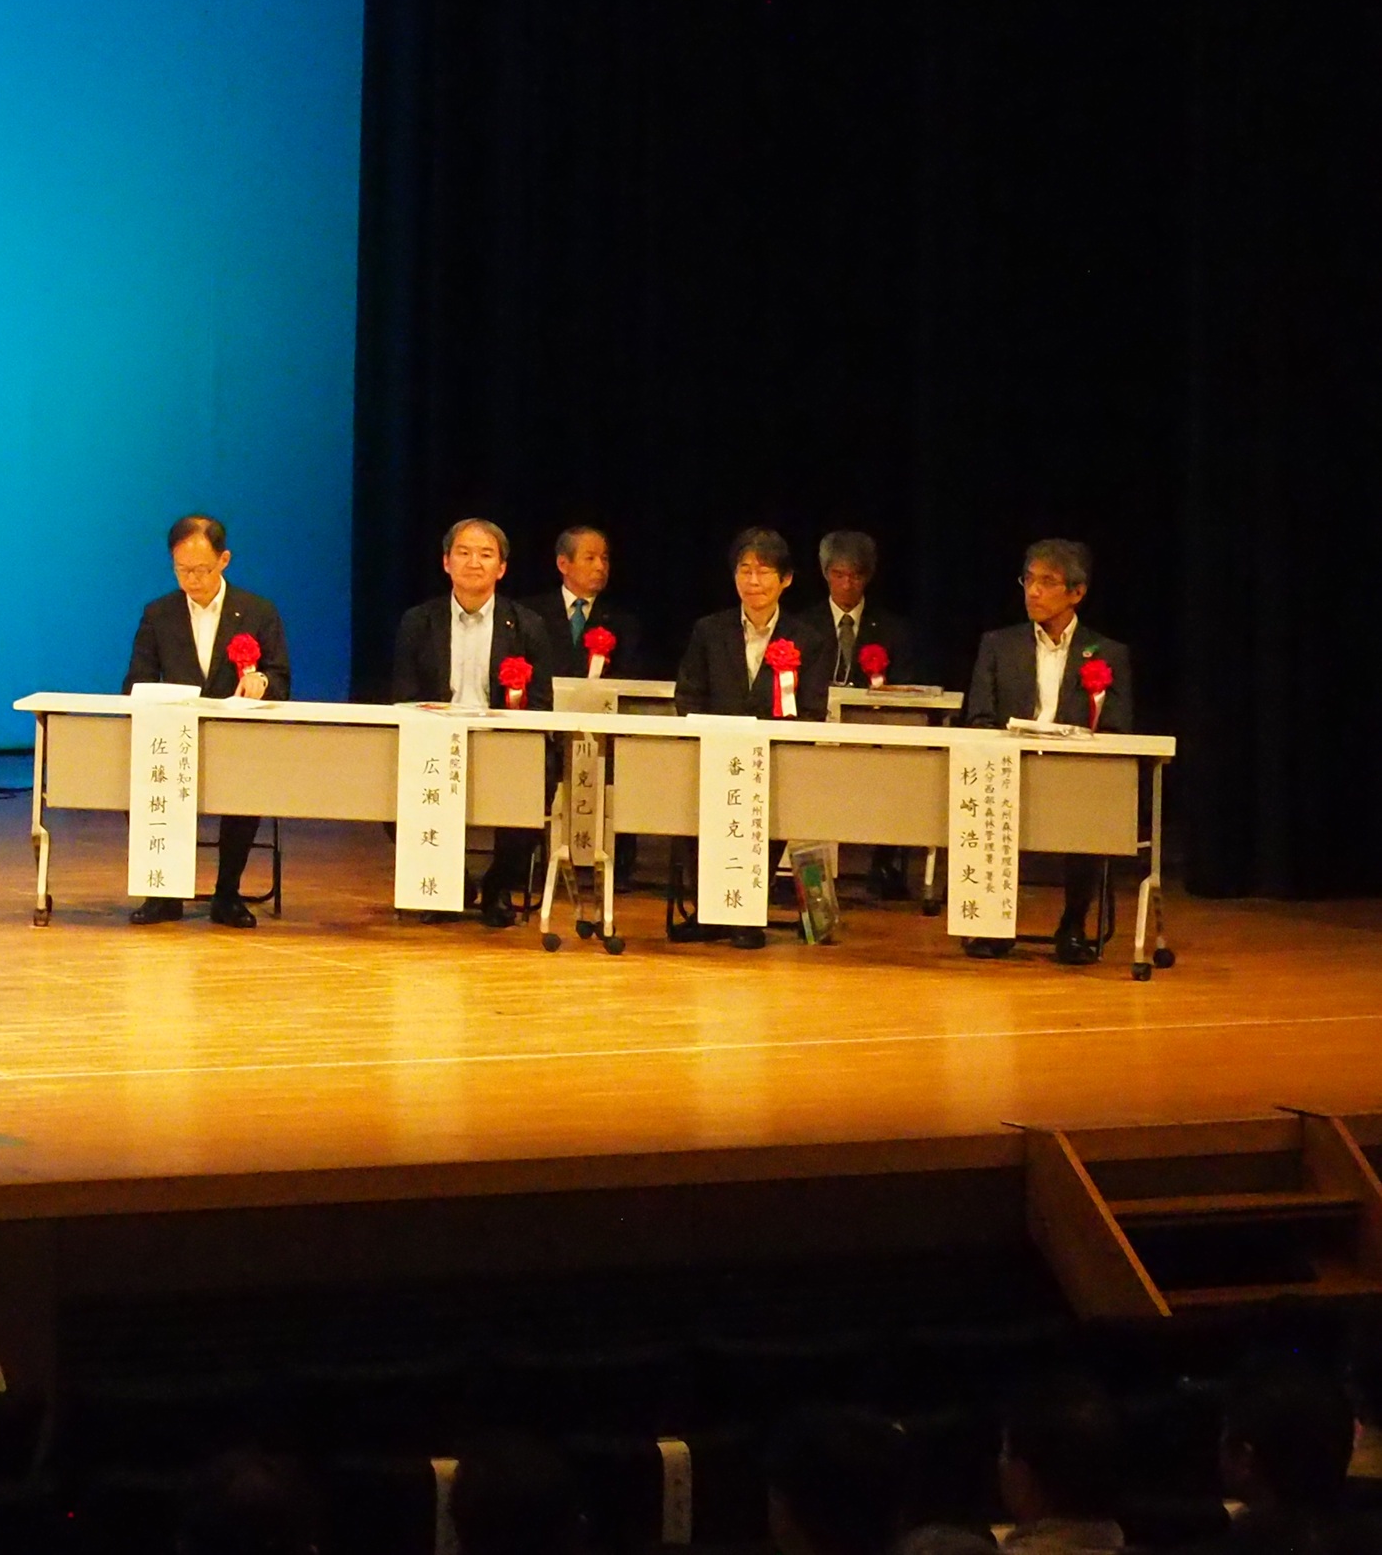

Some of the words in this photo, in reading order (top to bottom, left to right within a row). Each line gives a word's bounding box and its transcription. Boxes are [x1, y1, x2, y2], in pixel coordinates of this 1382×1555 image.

[177, 724, 192, 802] 大分県知事
